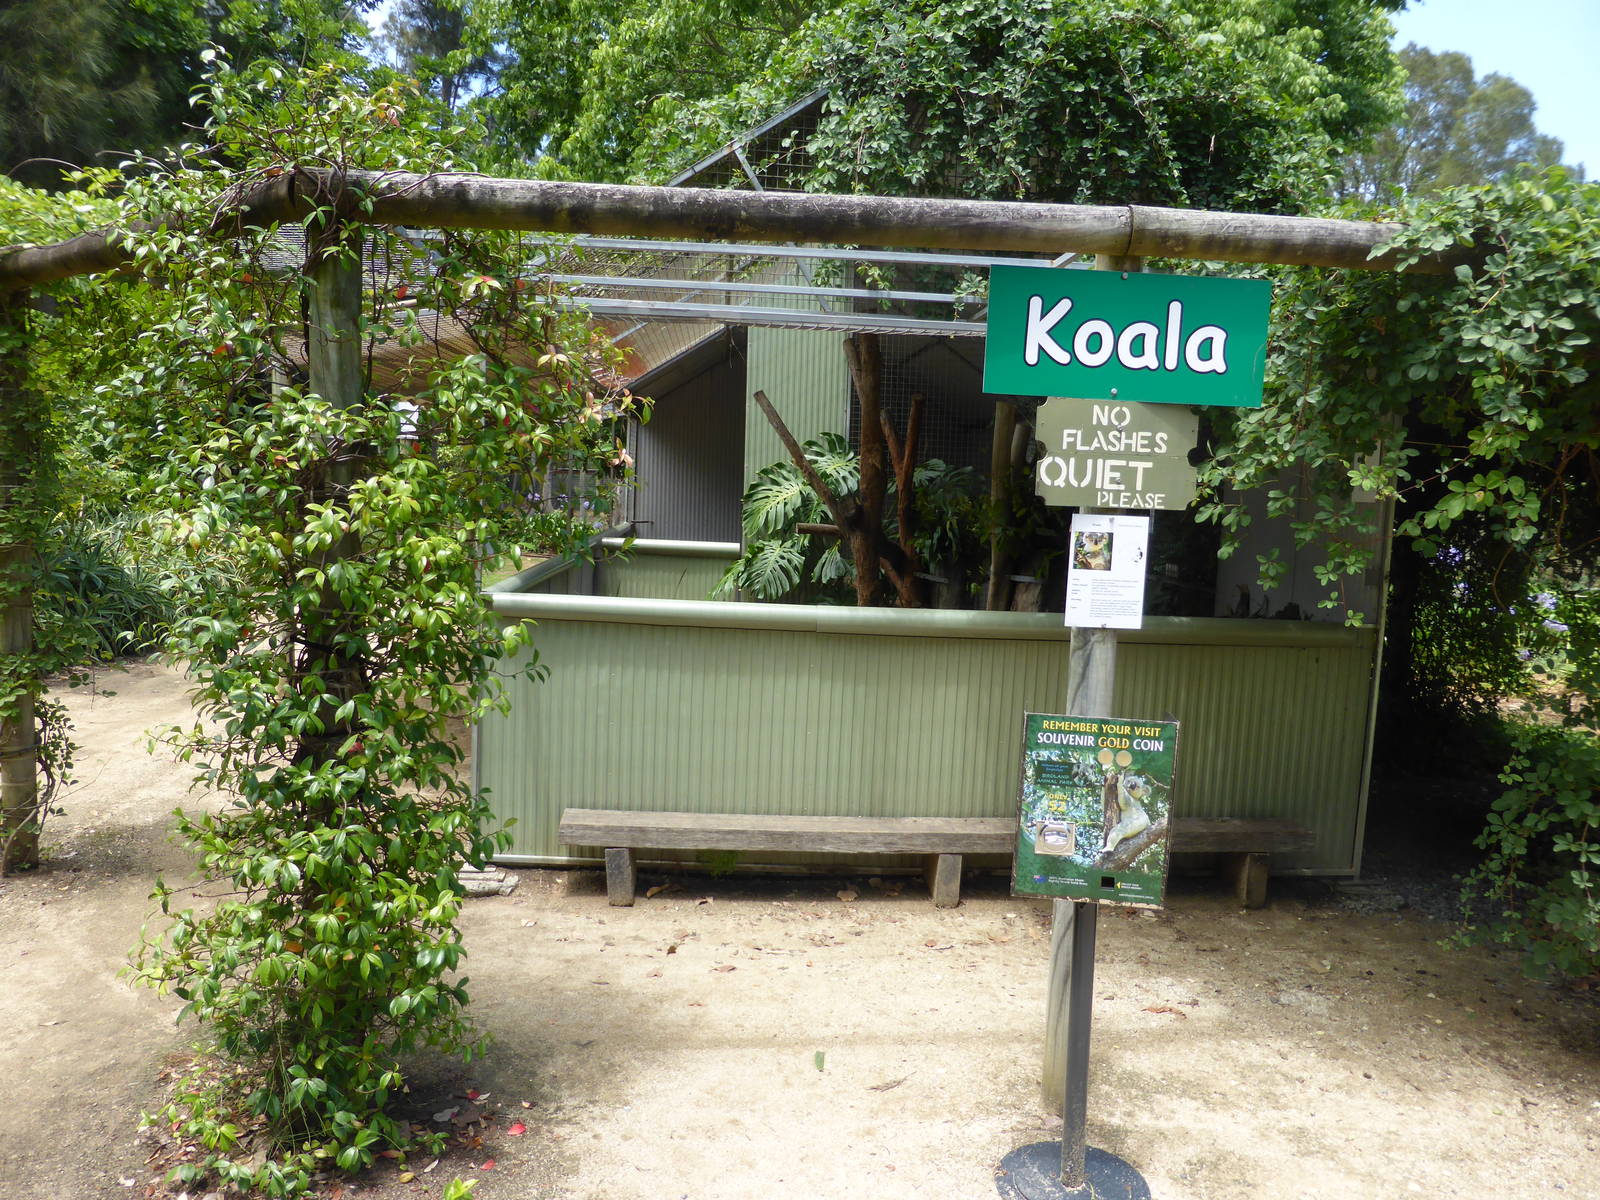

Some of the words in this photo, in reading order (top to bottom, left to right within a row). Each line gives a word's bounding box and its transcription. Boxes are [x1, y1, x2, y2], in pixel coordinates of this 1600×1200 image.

[1024, 294, 1228, 374] Koala
[1092, 405, 1131, 427] NO
[1062, 429, 1168, 454] FLASHES
[1039, 456, 1153, 491] QUIET
[1097, 491, 1165, 509] PLEASE
[1043, 720, 1098, 733] REMEMBER
[1102, 724, 1131, 735] YOUR
[1134, 726, 1161, 737] VISIT
[1037, 732, 1095, 747] SOUVENIR
[1098, 736, 1129, 749] GOLD
[1133, 739, 1164, 752] COIN
